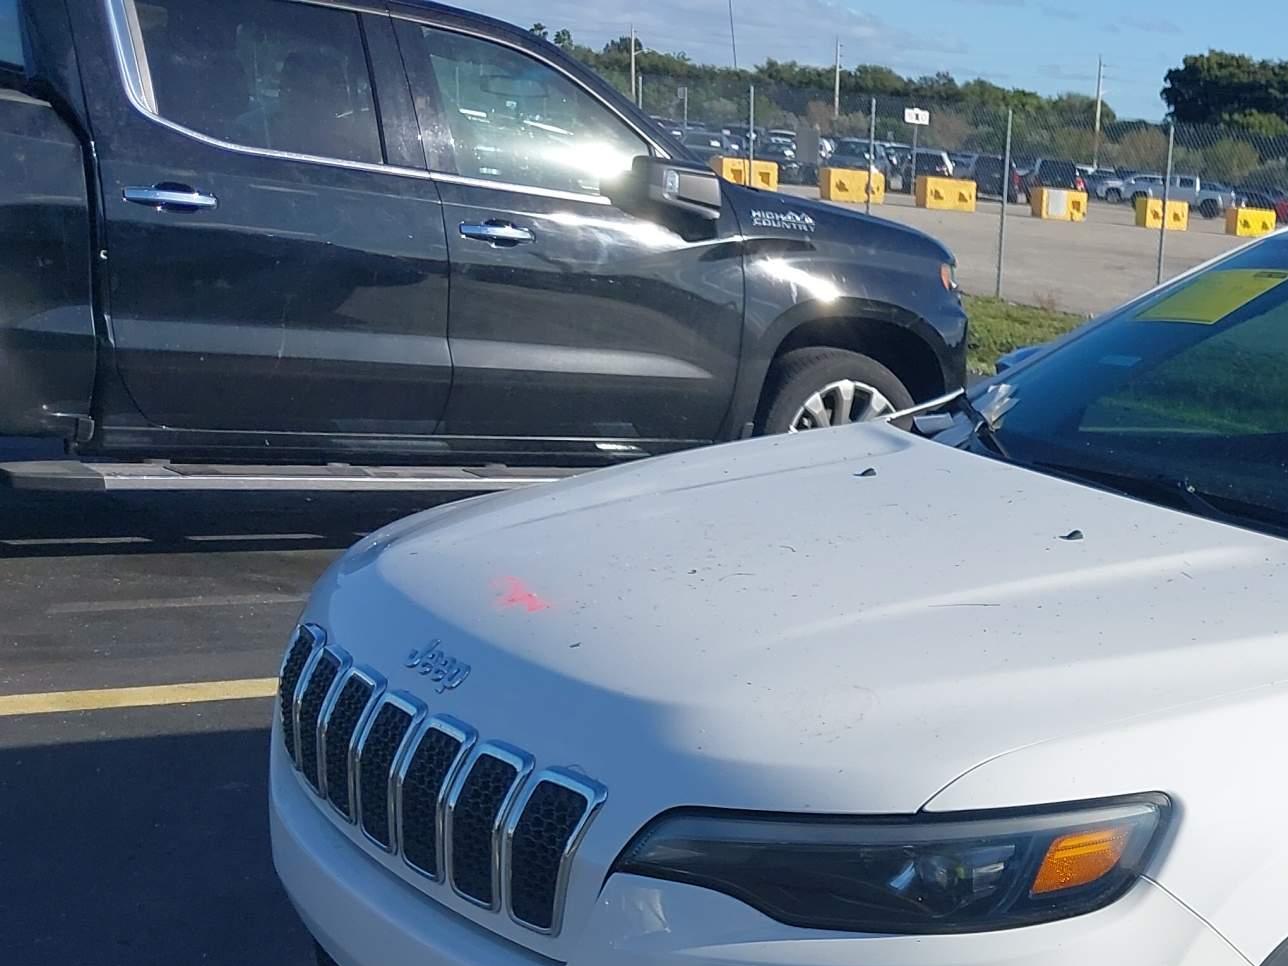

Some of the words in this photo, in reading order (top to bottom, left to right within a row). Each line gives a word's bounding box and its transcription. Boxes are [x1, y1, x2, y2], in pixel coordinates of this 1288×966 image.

[751, 209, 787, 220] HIGH
[752, 218, 816, 232] COUNTRY
[403, 638, 472, 695] Jeep
